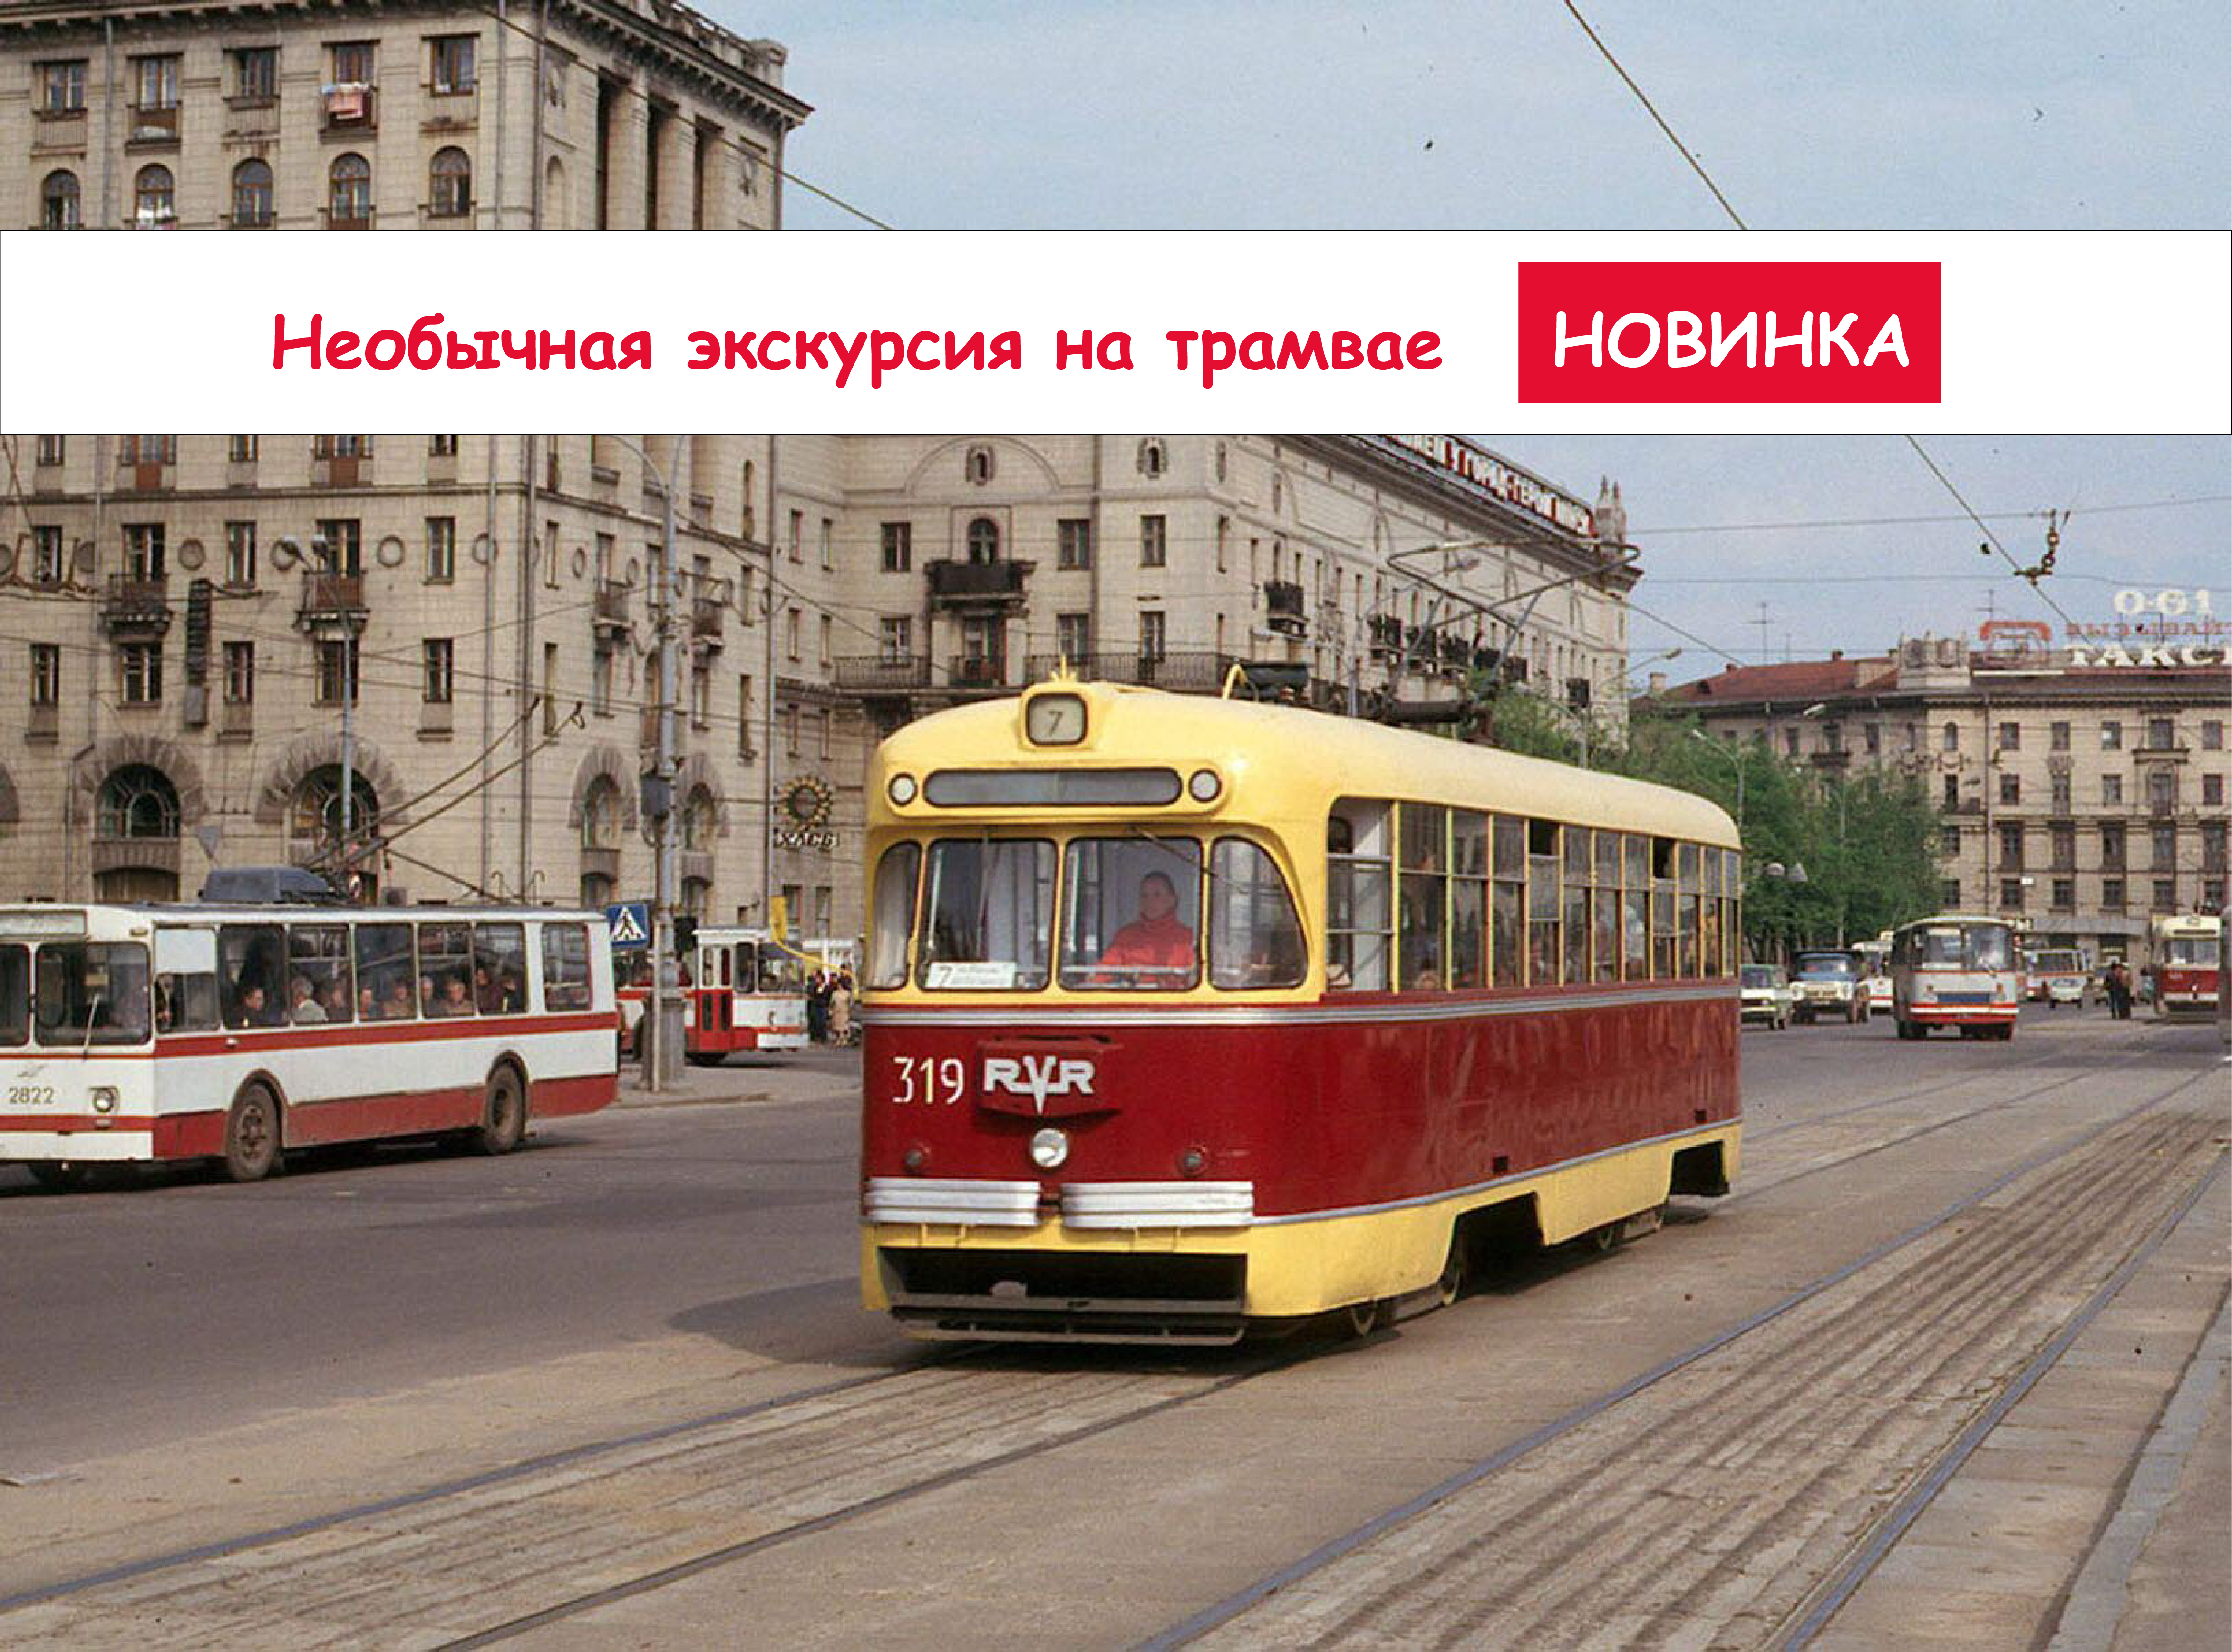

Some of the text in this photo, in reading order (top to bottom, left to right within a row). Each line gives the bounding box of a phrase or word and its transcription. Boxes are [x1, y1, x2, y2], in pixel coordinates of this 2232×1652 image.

[1047, 710, 1064, 737] 7
[8, 1086, 55, 1105] 2822
[892, 1056, 965, 1104] 319
[982, 1055, 1096, 1114] RVR
